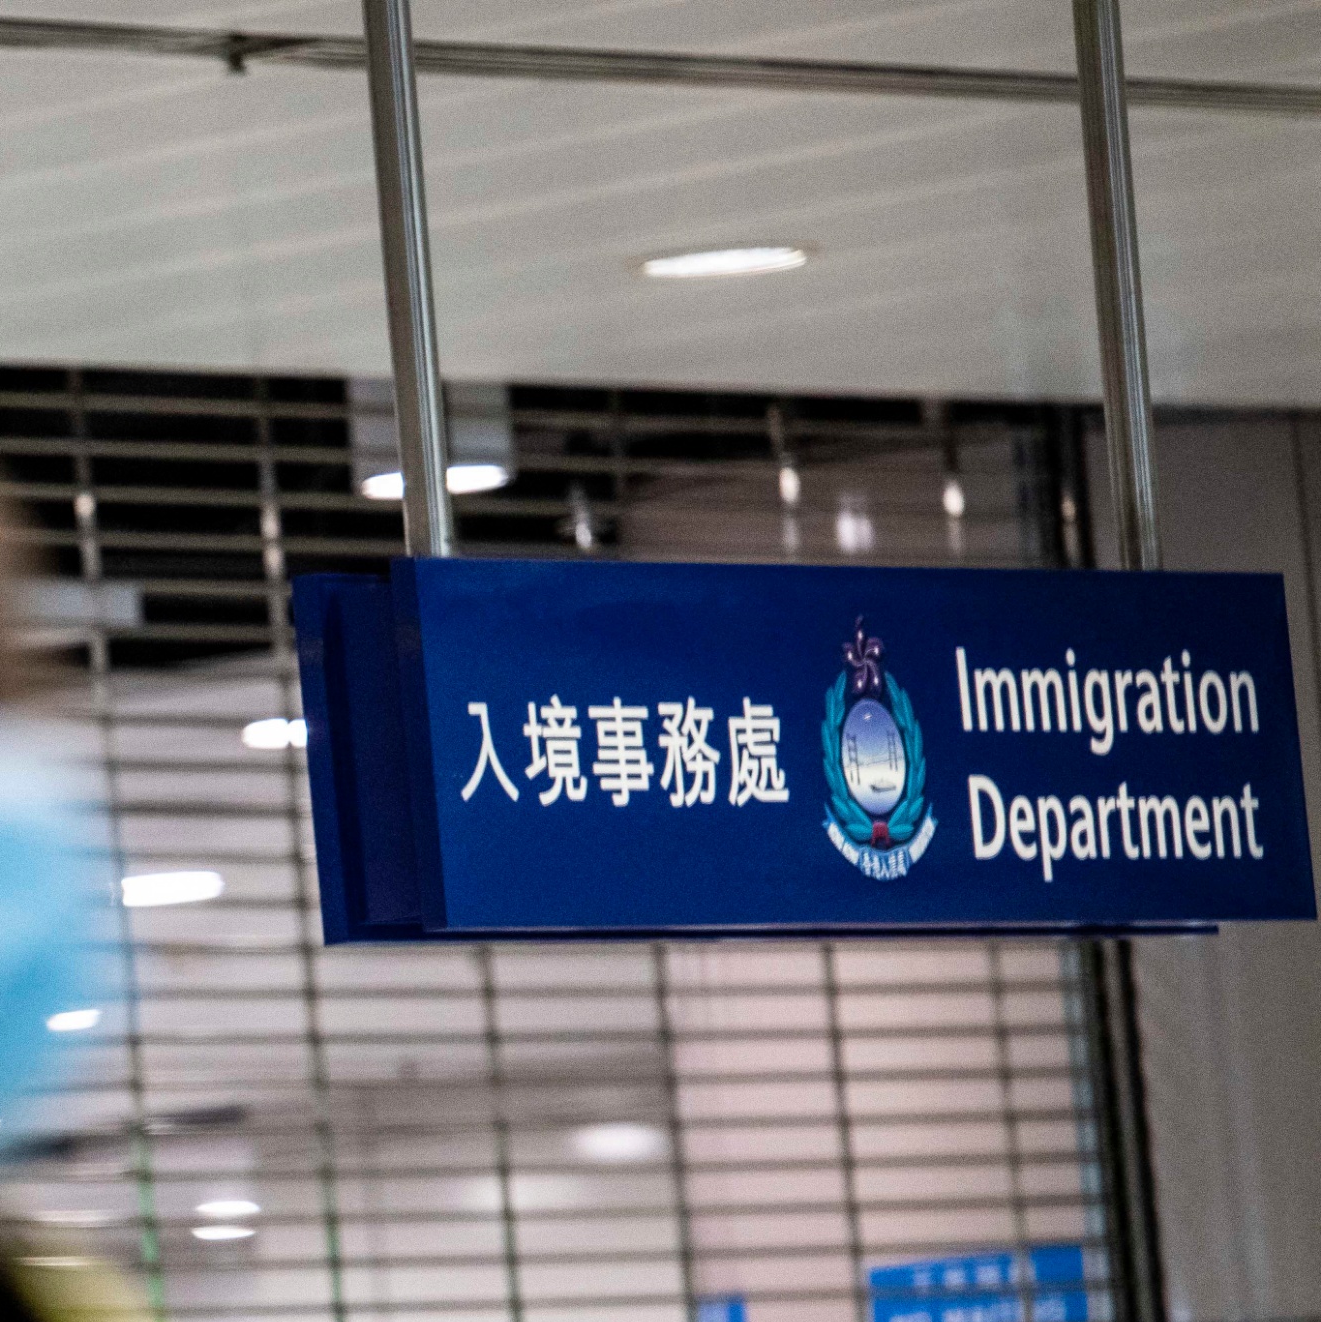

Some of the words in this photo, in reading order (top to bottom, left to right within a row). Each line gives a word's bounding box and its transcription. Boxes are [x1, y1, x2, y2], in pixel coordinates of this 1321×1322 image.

[461, 695, 789, 807] 入境事務處
[956, 648, 1258, 754] Immigration
[969, 775, 1262, 881] Department
